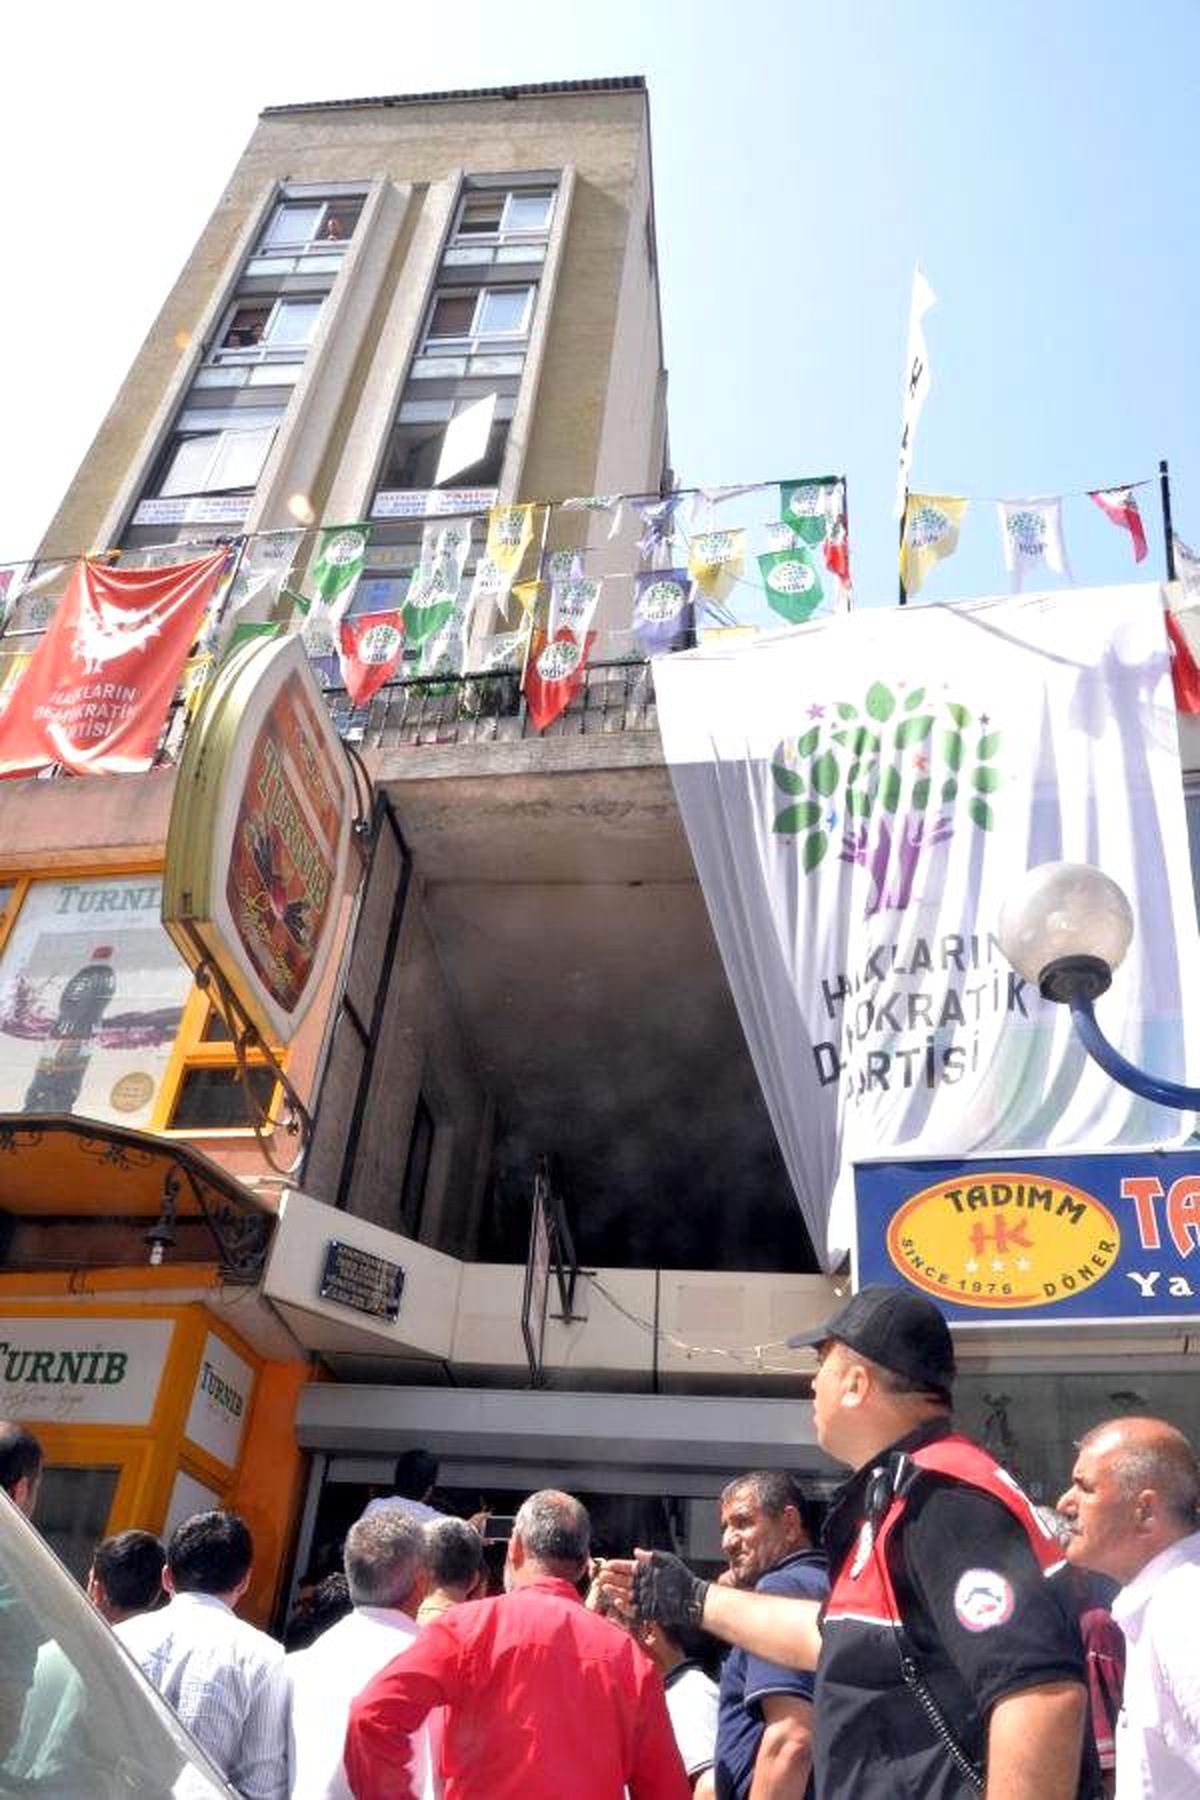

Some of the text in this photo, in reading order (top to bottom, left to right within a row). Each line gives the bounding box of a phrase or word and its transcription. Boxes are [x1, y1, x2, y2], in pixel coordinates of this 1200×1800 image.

[944, 1184, 1087, 1225] TADIMM
[969, 1213, 1035, 1257] HK
[902, 1238, 1012, 1295] SINCE 1976
